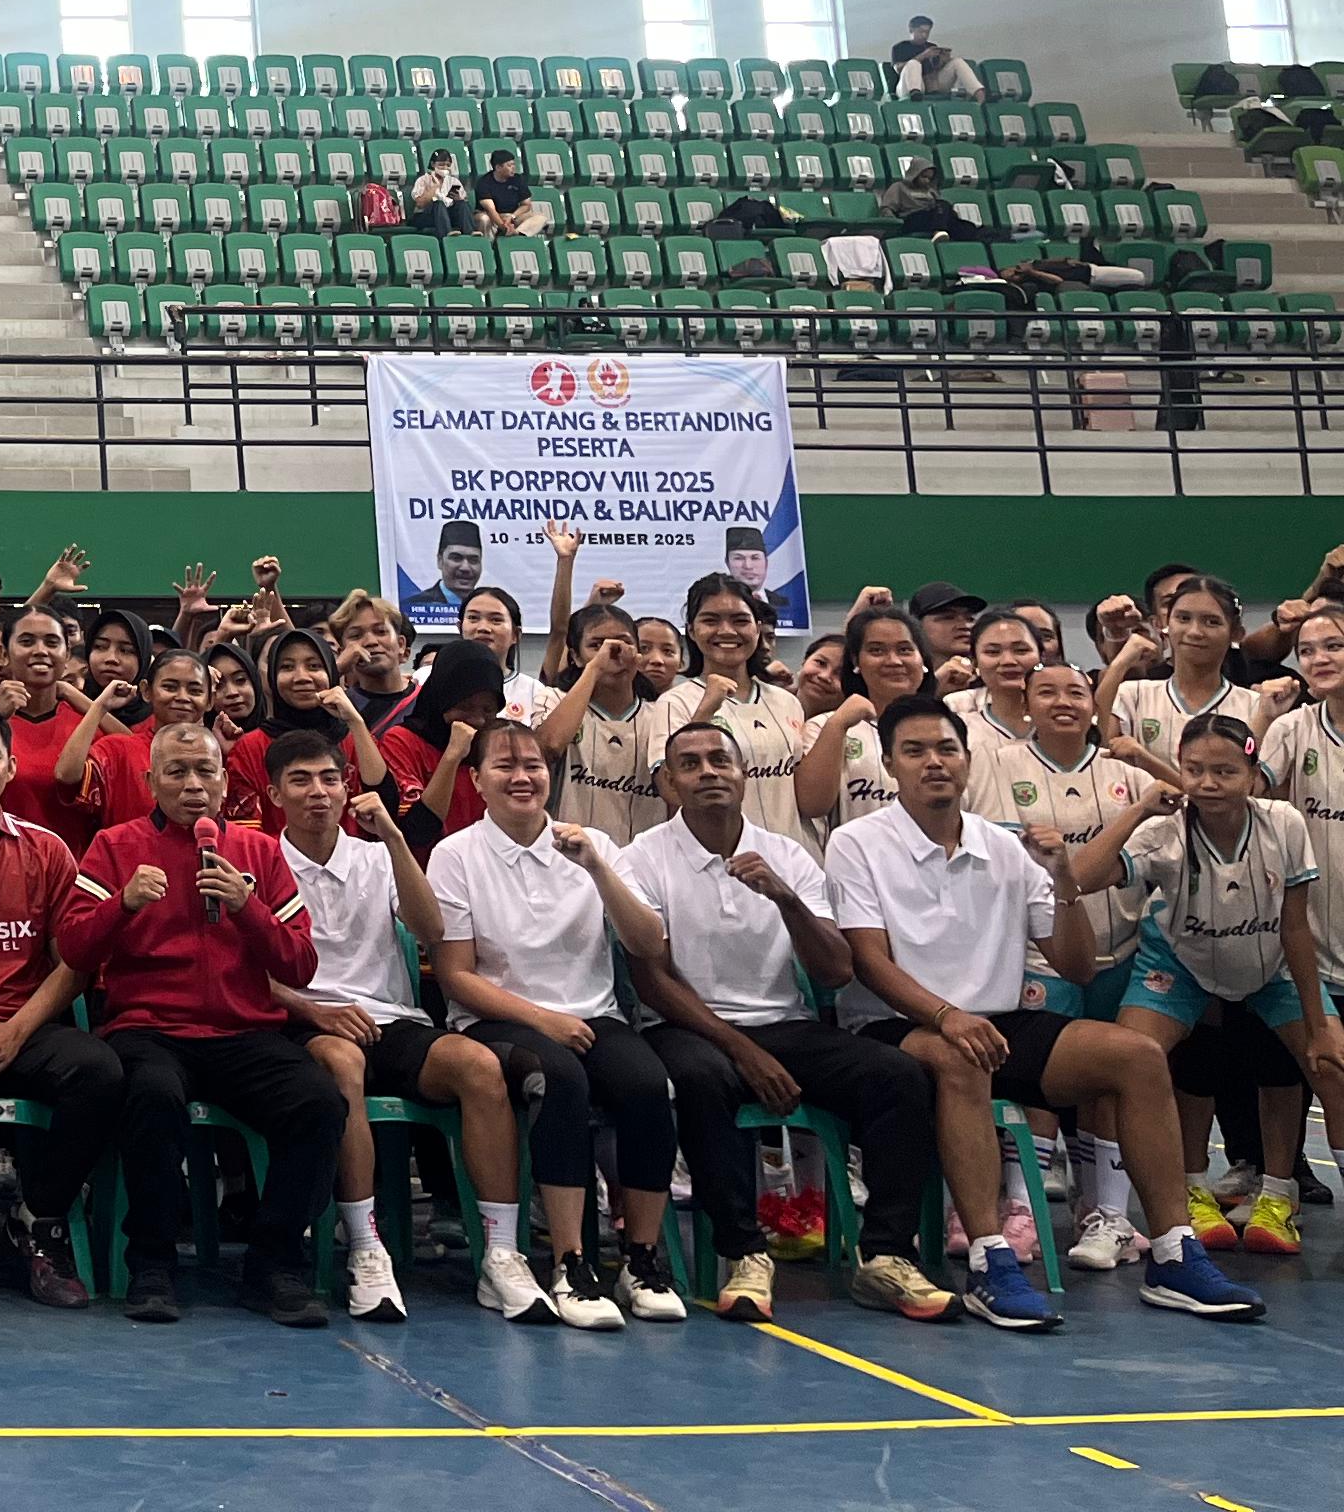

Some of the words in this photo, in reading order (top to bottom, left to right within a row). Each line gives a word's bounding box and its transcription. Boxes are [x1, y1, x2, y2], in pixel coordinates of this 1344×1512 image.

[393, 409, 495, 430] SELAMAT
[502, 410, 595, 431] DATANG
[602, 411, 620, 431] &
[625, 411, 772, 432] BERTANDING
[537, 436, 635, 458] PESERTA
[451, 469, 486, 491] BK
[490, 470, 606, 492] PORPROV
[611, 470, 649, 493] VIII
[655, 471, 715, 493] 2025
[409, 497, 434, 520] DI
[441, 498, 589, 520] SAMARINDA
[594, 499, 615, 521] &
[619, 499, 772, 522] BALIKPAPAN
[490, 533, 508, 544] 10
[526, 533, 545, 544] 15
[567, 533, 648, 546] VEMBER
[655, 533, 695, 546] 2025
